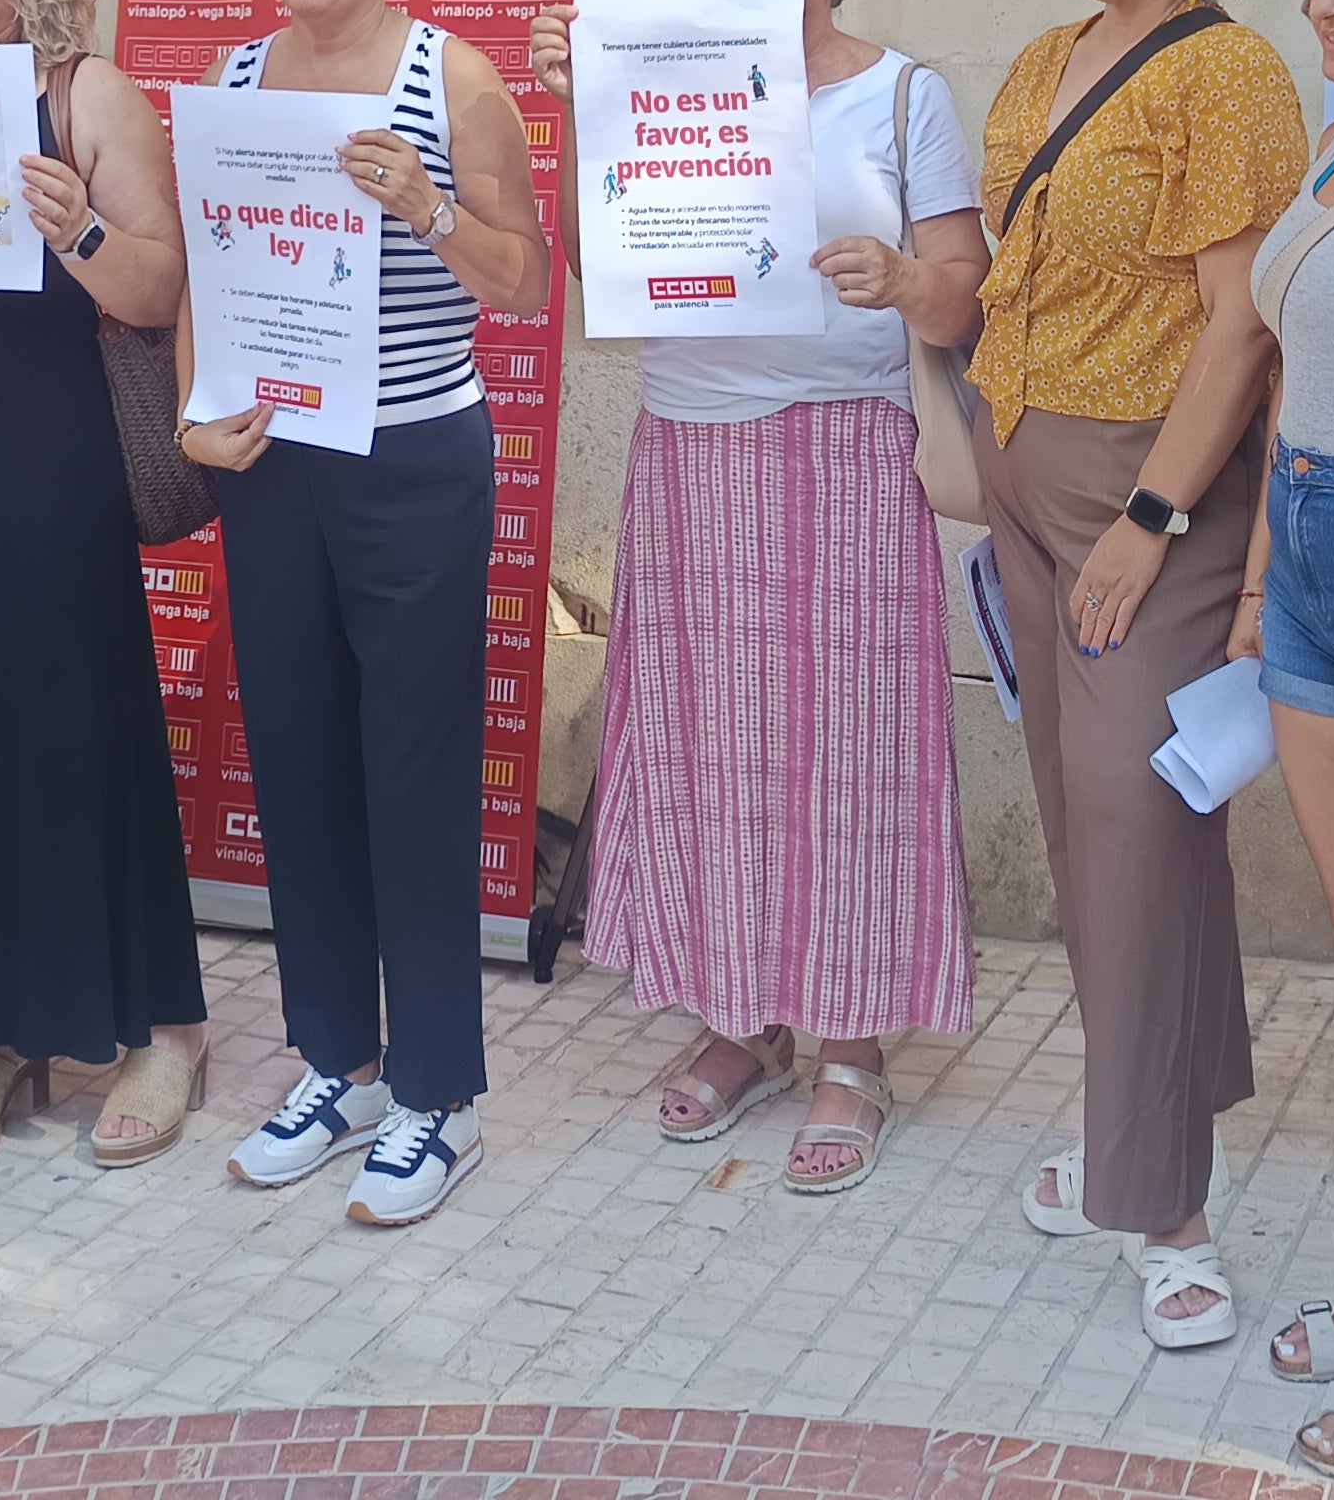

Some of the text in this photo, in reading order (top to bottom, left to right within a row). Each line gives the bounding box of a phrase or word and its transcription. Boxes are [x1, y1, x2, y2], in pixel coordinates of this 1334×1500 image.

[127, 4, 252, 20] vinalopó vega baja
[432, 4, 493, 20] vinalopó
[506, 4, 535, 18] vega
[602, 43, 625, 51] Tienes
[627, 43, 640, 51] que
[663, 41, 693, 49] cubierta
[721, 38, 767, 46] necesidades
[631, 91, 747, 114] No es un
[635, 122, 749, 148] favor, es
[617, 151, 771, 183] prevención
[203, 199, 363, 234] Lo que dice la
[630, 231, 647, 239] Ropa
[270, 233, 304, 265] ley
[652, 280, 708, 296] CCOO
[489, 312, 518, 327] vega
[259, 382, 301, 401] CCOO
[517, 390, 544, 407] baja
[513, 470, 539, 488] baja
[507, 550, 535, 568] baja
[153, 604, 209, 622] vega baja
[177, 682, 203, 699] baja
[487, 880, 517, 899] baja
